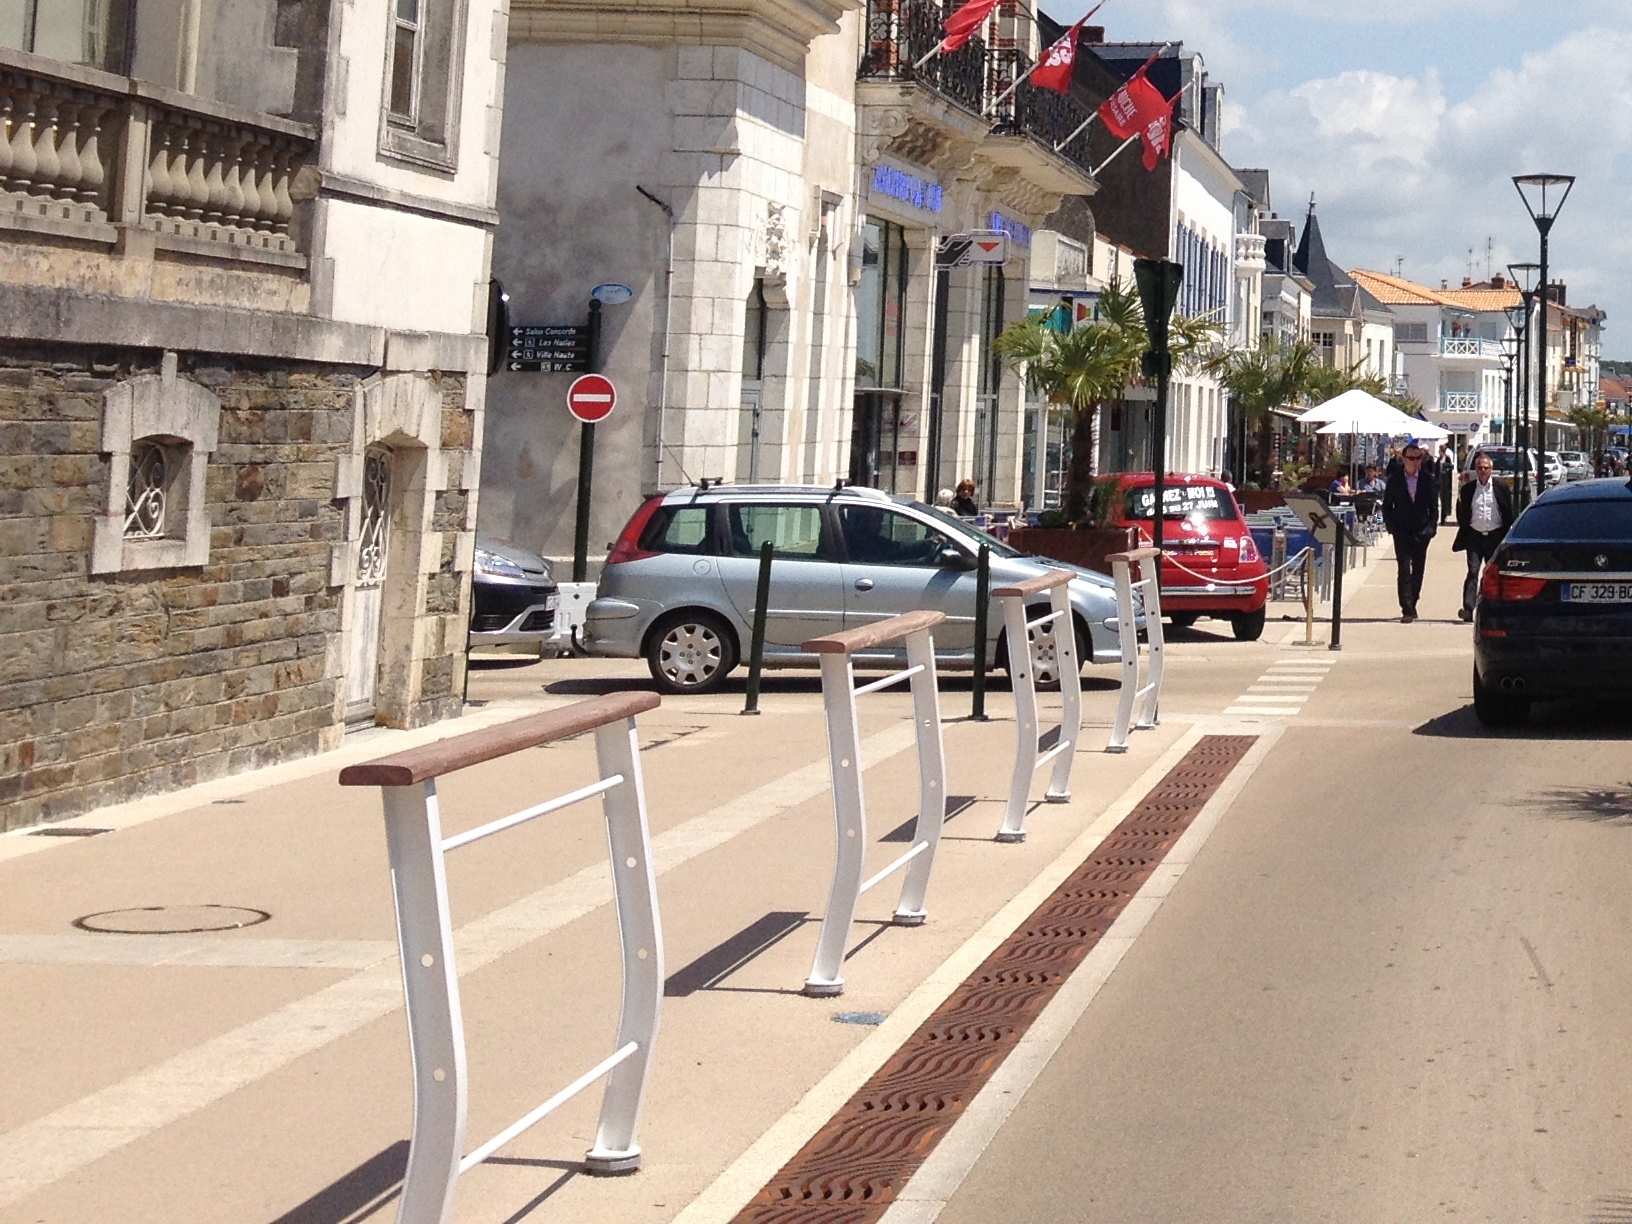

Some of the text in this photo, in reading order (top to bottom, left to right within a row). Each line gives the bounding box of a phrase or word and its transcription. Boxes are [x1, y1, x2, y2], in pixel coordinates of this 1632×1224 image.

[538, 338, 576, 347] Les Halles
[536, 350, 575, 359] Ville Haute
[1182, 501, 1194, 510] 27
[1506, 559, 1530, 567] GT
